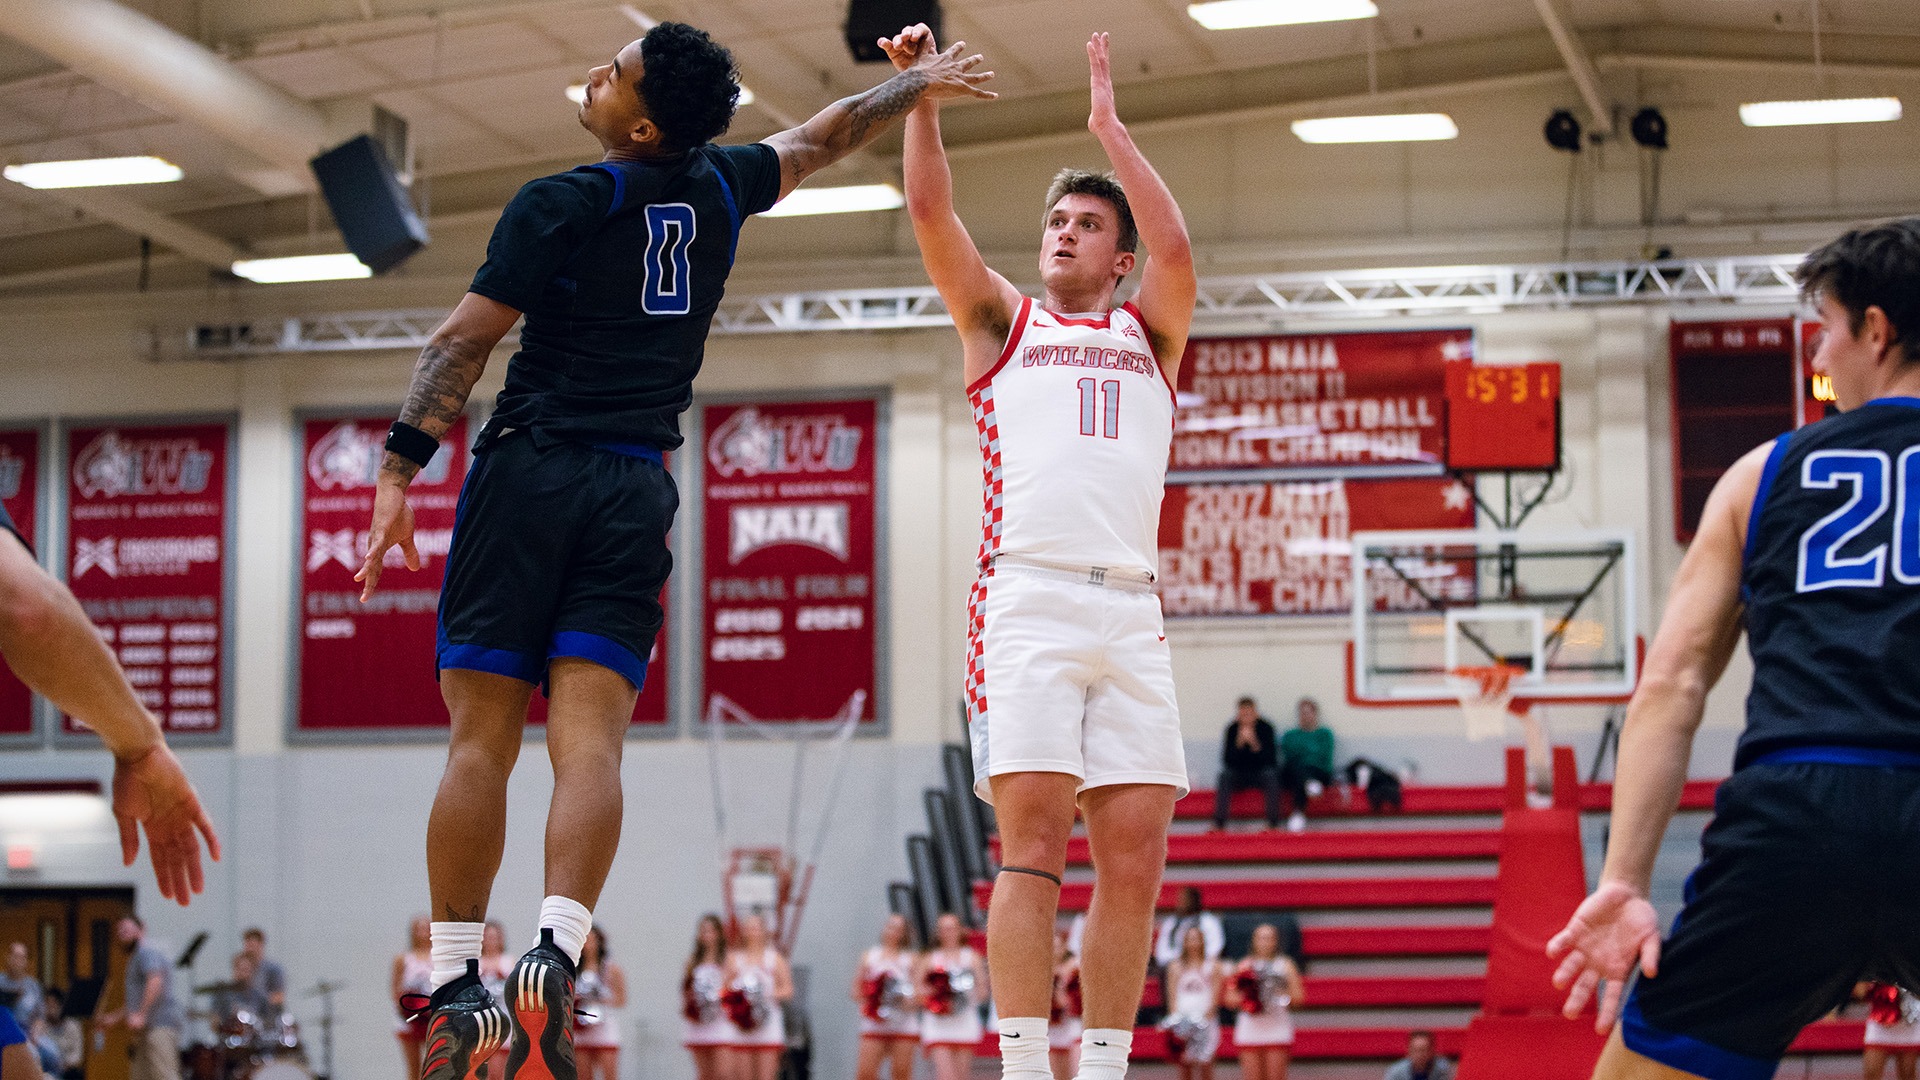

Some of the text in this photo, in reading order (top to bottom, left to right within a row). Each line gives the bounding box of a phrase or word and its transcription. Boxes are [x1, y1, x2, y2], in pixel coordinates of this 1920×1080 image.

[642, 203, 696, 314] 0
[1022, 345, 1154, 378] WILDCATS
[1268, 339, 1340, 369] NAIA
[1193, 373, 1318, 402] DIVISION
[1077, 377, 1120, 439] 11
[1175, 434, 1262, 464] IONAL
[728, 503, 850, 564] NAIA
[1184, 516, 1321, 551] DIVISION
[1159, 549, 1233, 584] EN'S
[1162, 584, 1260, 613] IONAL
